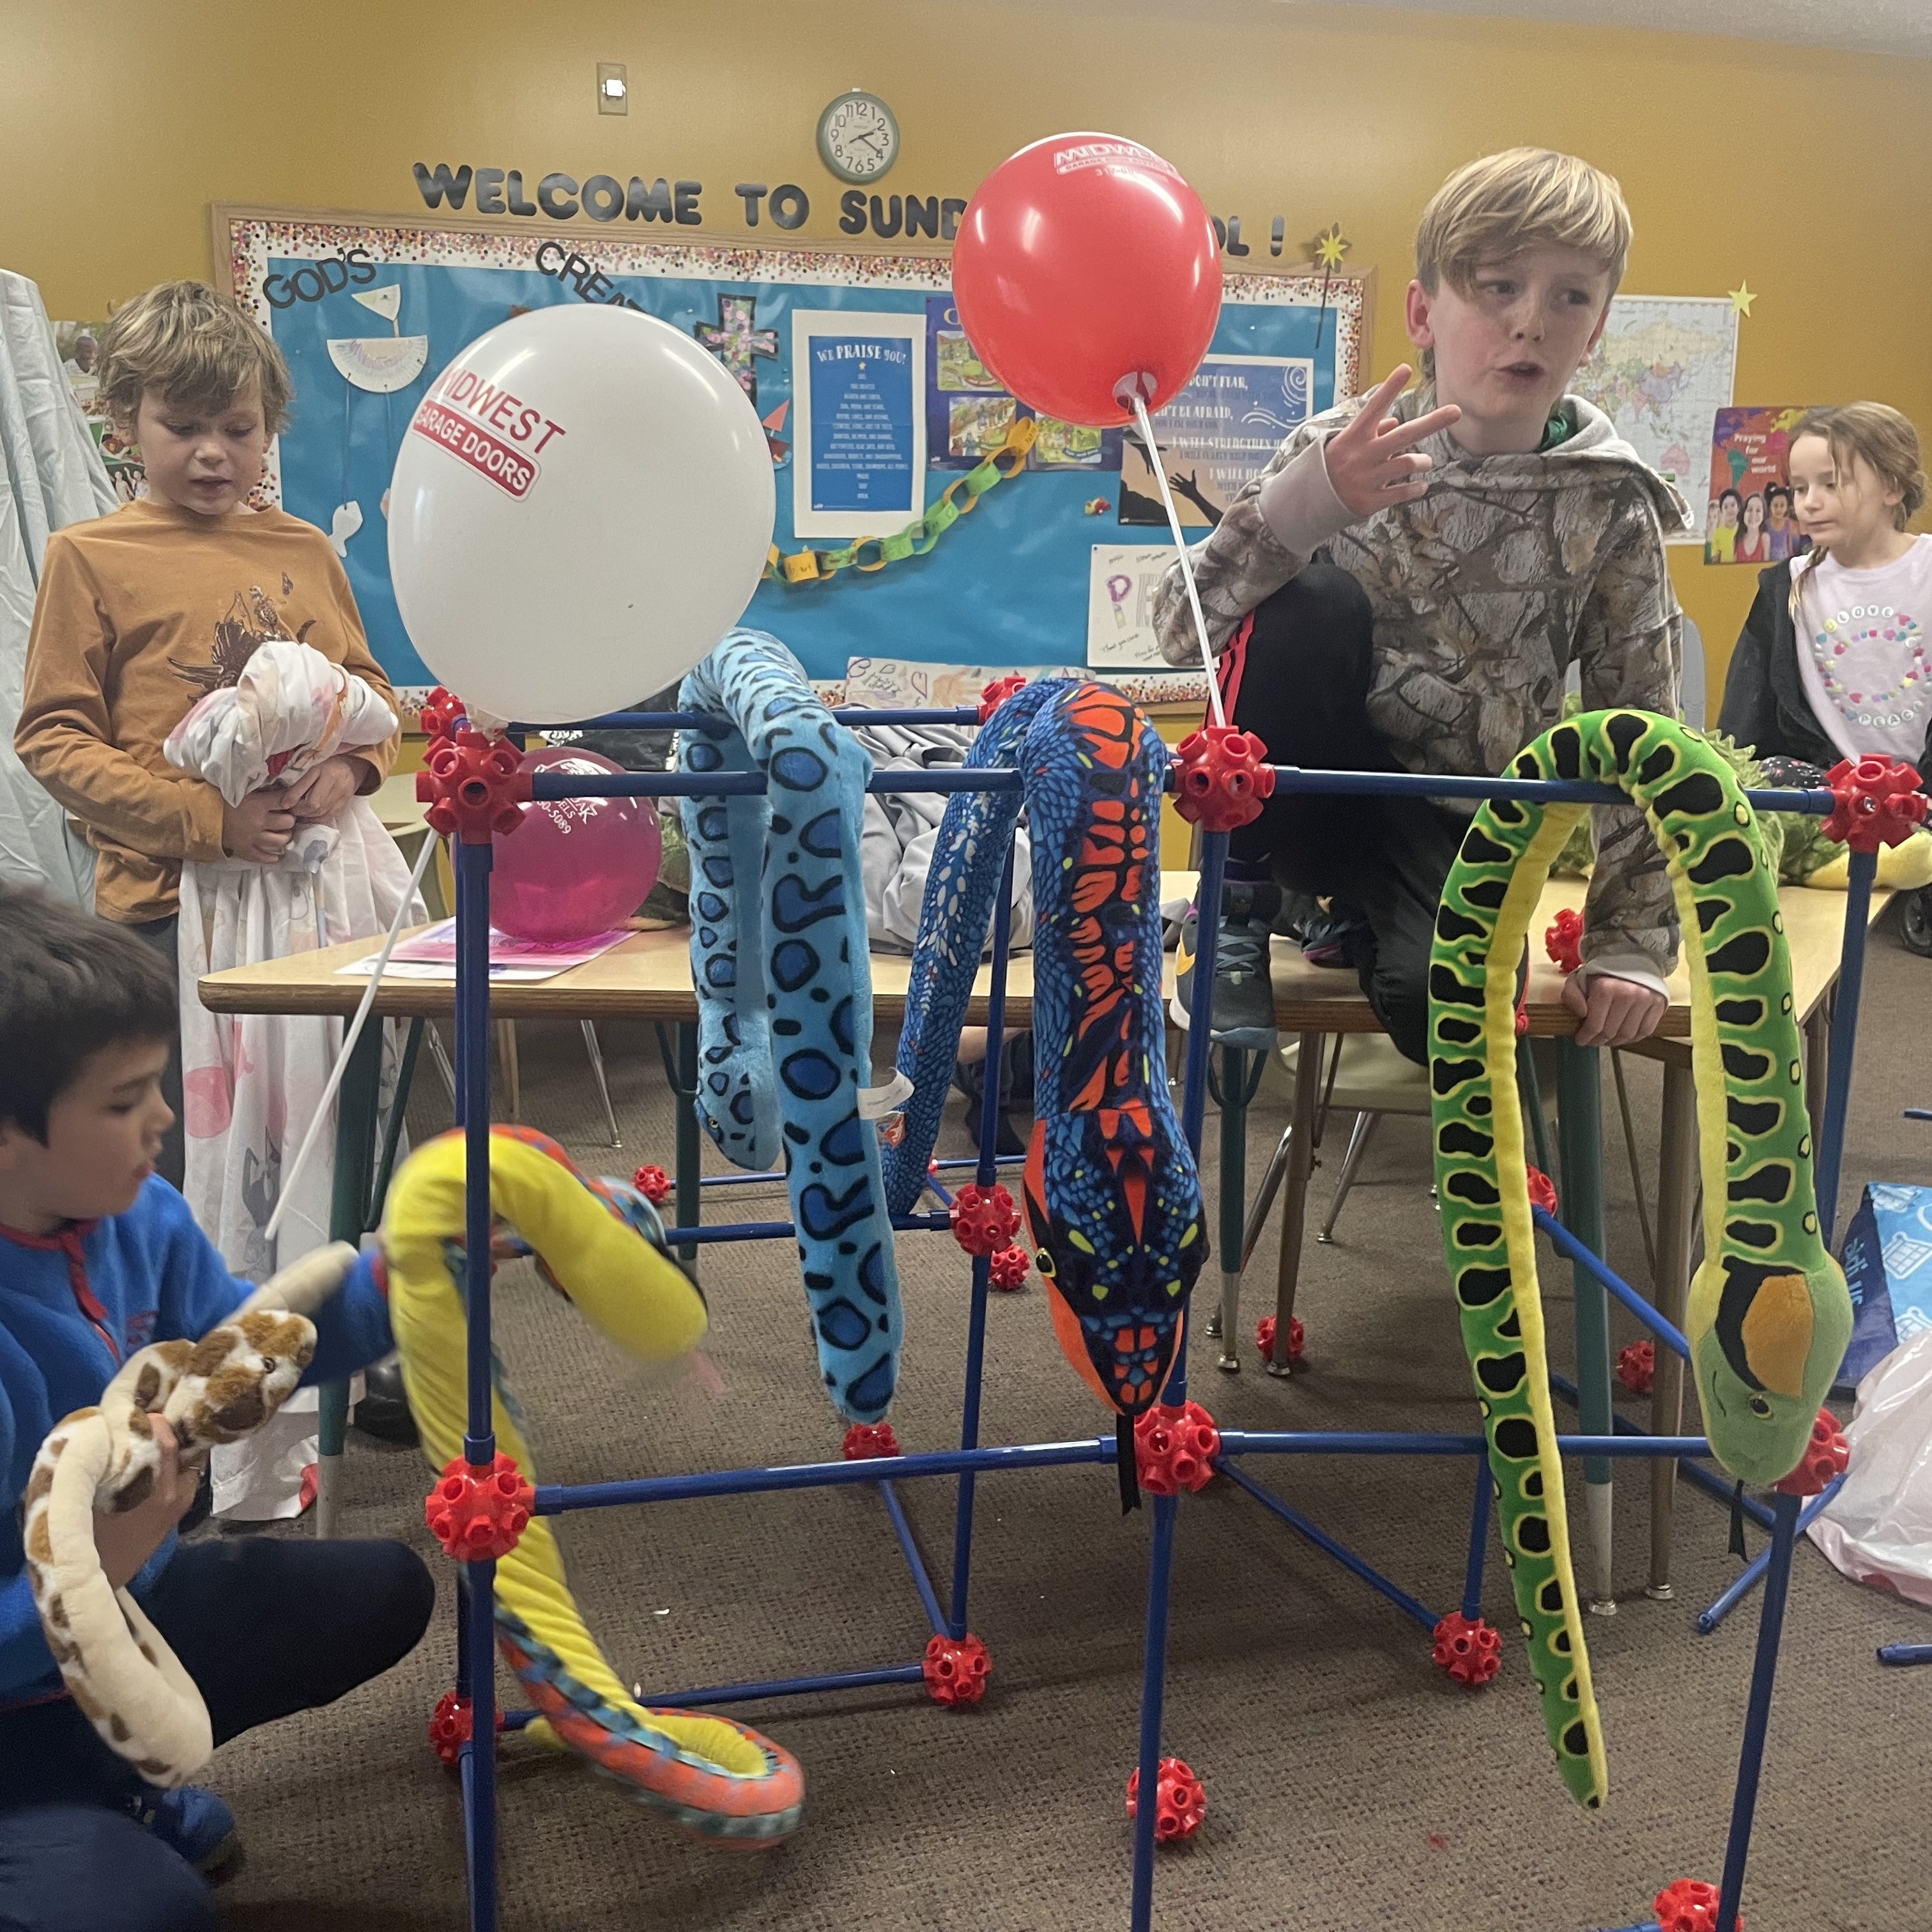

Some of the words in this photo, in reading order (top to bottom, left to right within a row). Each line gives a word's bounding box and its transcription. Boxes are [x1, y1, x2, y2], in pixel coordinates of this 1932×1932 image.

[845, 104, 854, 118] 11
[855, 102, 868, 116] 12
[871, 106, 875, 119] 1
[835, 114, 847, 127] 10
[877, 118, 885, 131] 2
[831, 128, 839, 142] 9
[881, 133, 889, 146] 3
[834, 144, 843, 158] 8
[876, 148, 884, 160] 4
[845, 157, 854, 169] 7
[855, 160, 864, 174] 6
[866, 158, 875, 171] 5
[413, 163, 702, 226] WELCOME
[735, 183, 809, 230] TO
[839, 190, 968, 241] SUND
[263, 247, 377, 309] GOD'S
[816, 349, 834, 362] WE
[836, 344, 882, 359] PRAISE
[884, 349, 907, 365] YOU!
[1734, 433, 1766, 444] Praying
[416, 405, 466, 446] GARAGE
[461, 432, 531, 490] DOORS
[1216, 468, 1243, 480] WILL
[1837, 605, 1894, 624] LOVE
